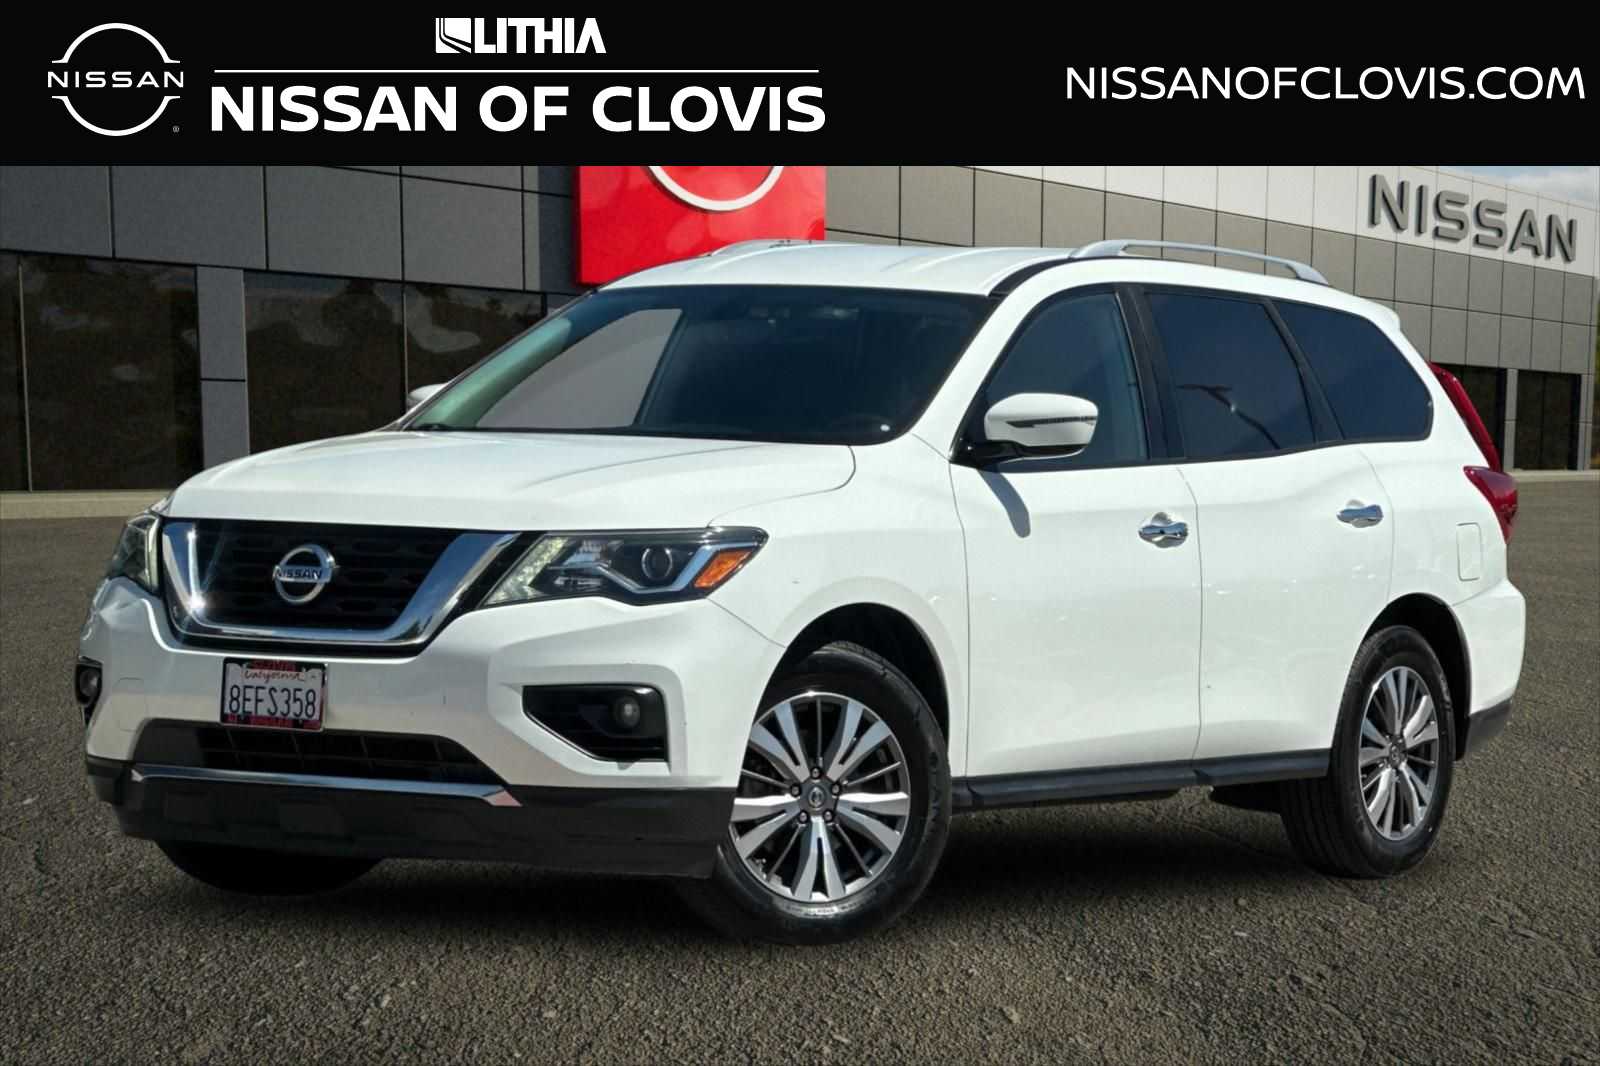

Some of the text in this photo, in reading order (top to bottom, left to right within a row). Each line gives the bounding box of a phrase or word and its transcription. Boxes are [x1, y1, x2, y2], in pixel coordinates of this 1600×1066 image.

[1368, 173, 1578, 262] NISSAN
[274, 566, 323, 580] NISSAN
[229, 684, 316, 718] 8EFS358
